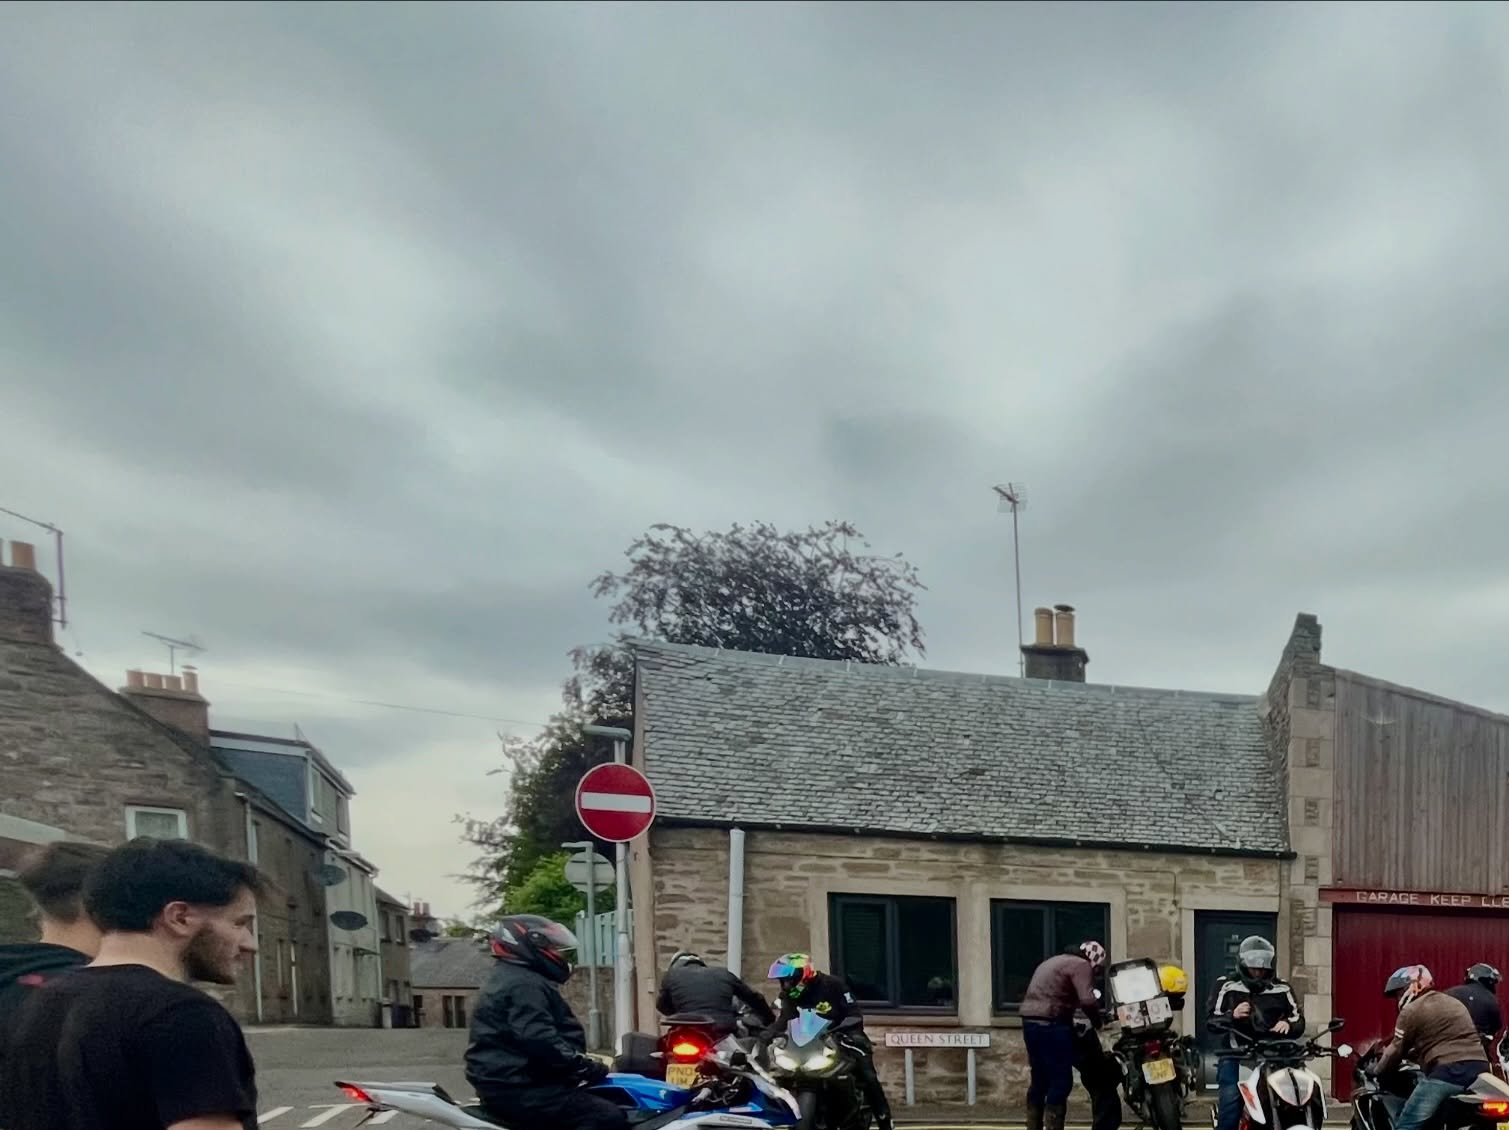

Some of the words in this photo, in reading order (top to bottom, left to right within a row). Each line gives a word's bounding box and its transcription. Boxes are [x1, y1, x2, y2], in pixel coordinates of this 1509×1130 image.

[1356, 890, 1420, 905] GARAGE
[1430, 893, 1472, 907] KEEP
[890, 1033, 934, 1045] QUEEN
[939, 1034, 985, 1045] STREET
